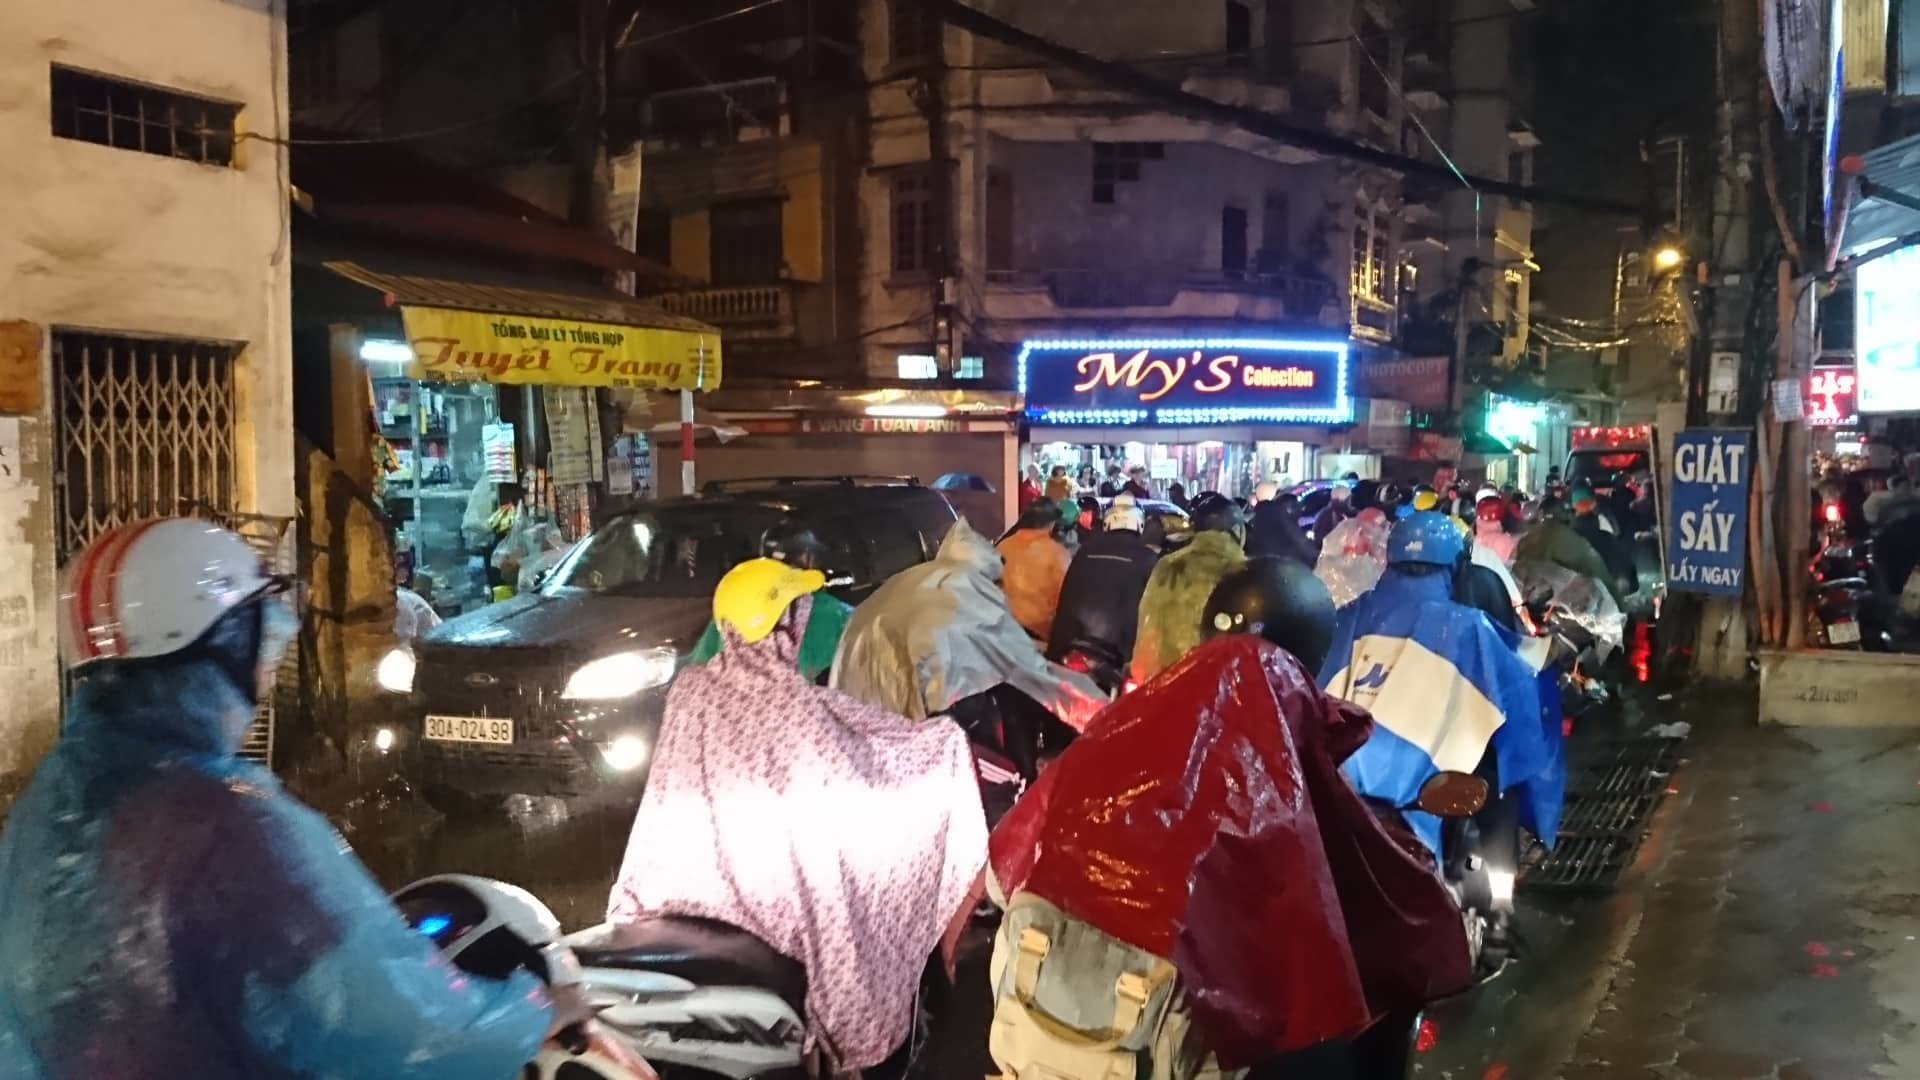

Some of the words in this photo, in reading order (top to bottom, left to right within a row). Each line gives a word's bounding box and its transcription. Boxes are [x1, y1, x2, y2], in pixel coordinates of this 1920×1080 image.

[413, 336, 550, 375] Tuyết
[570, 347, 682, 383] Trang
[1243, 365, 1315, 388] Collection
[1675, 436, 1745, 493] GIẶT
[1680, 499, 1735, 552] SẤY
[1670, 556, 1698, 582] LẤY
[1701, 565, 1741, 587] NGAY
